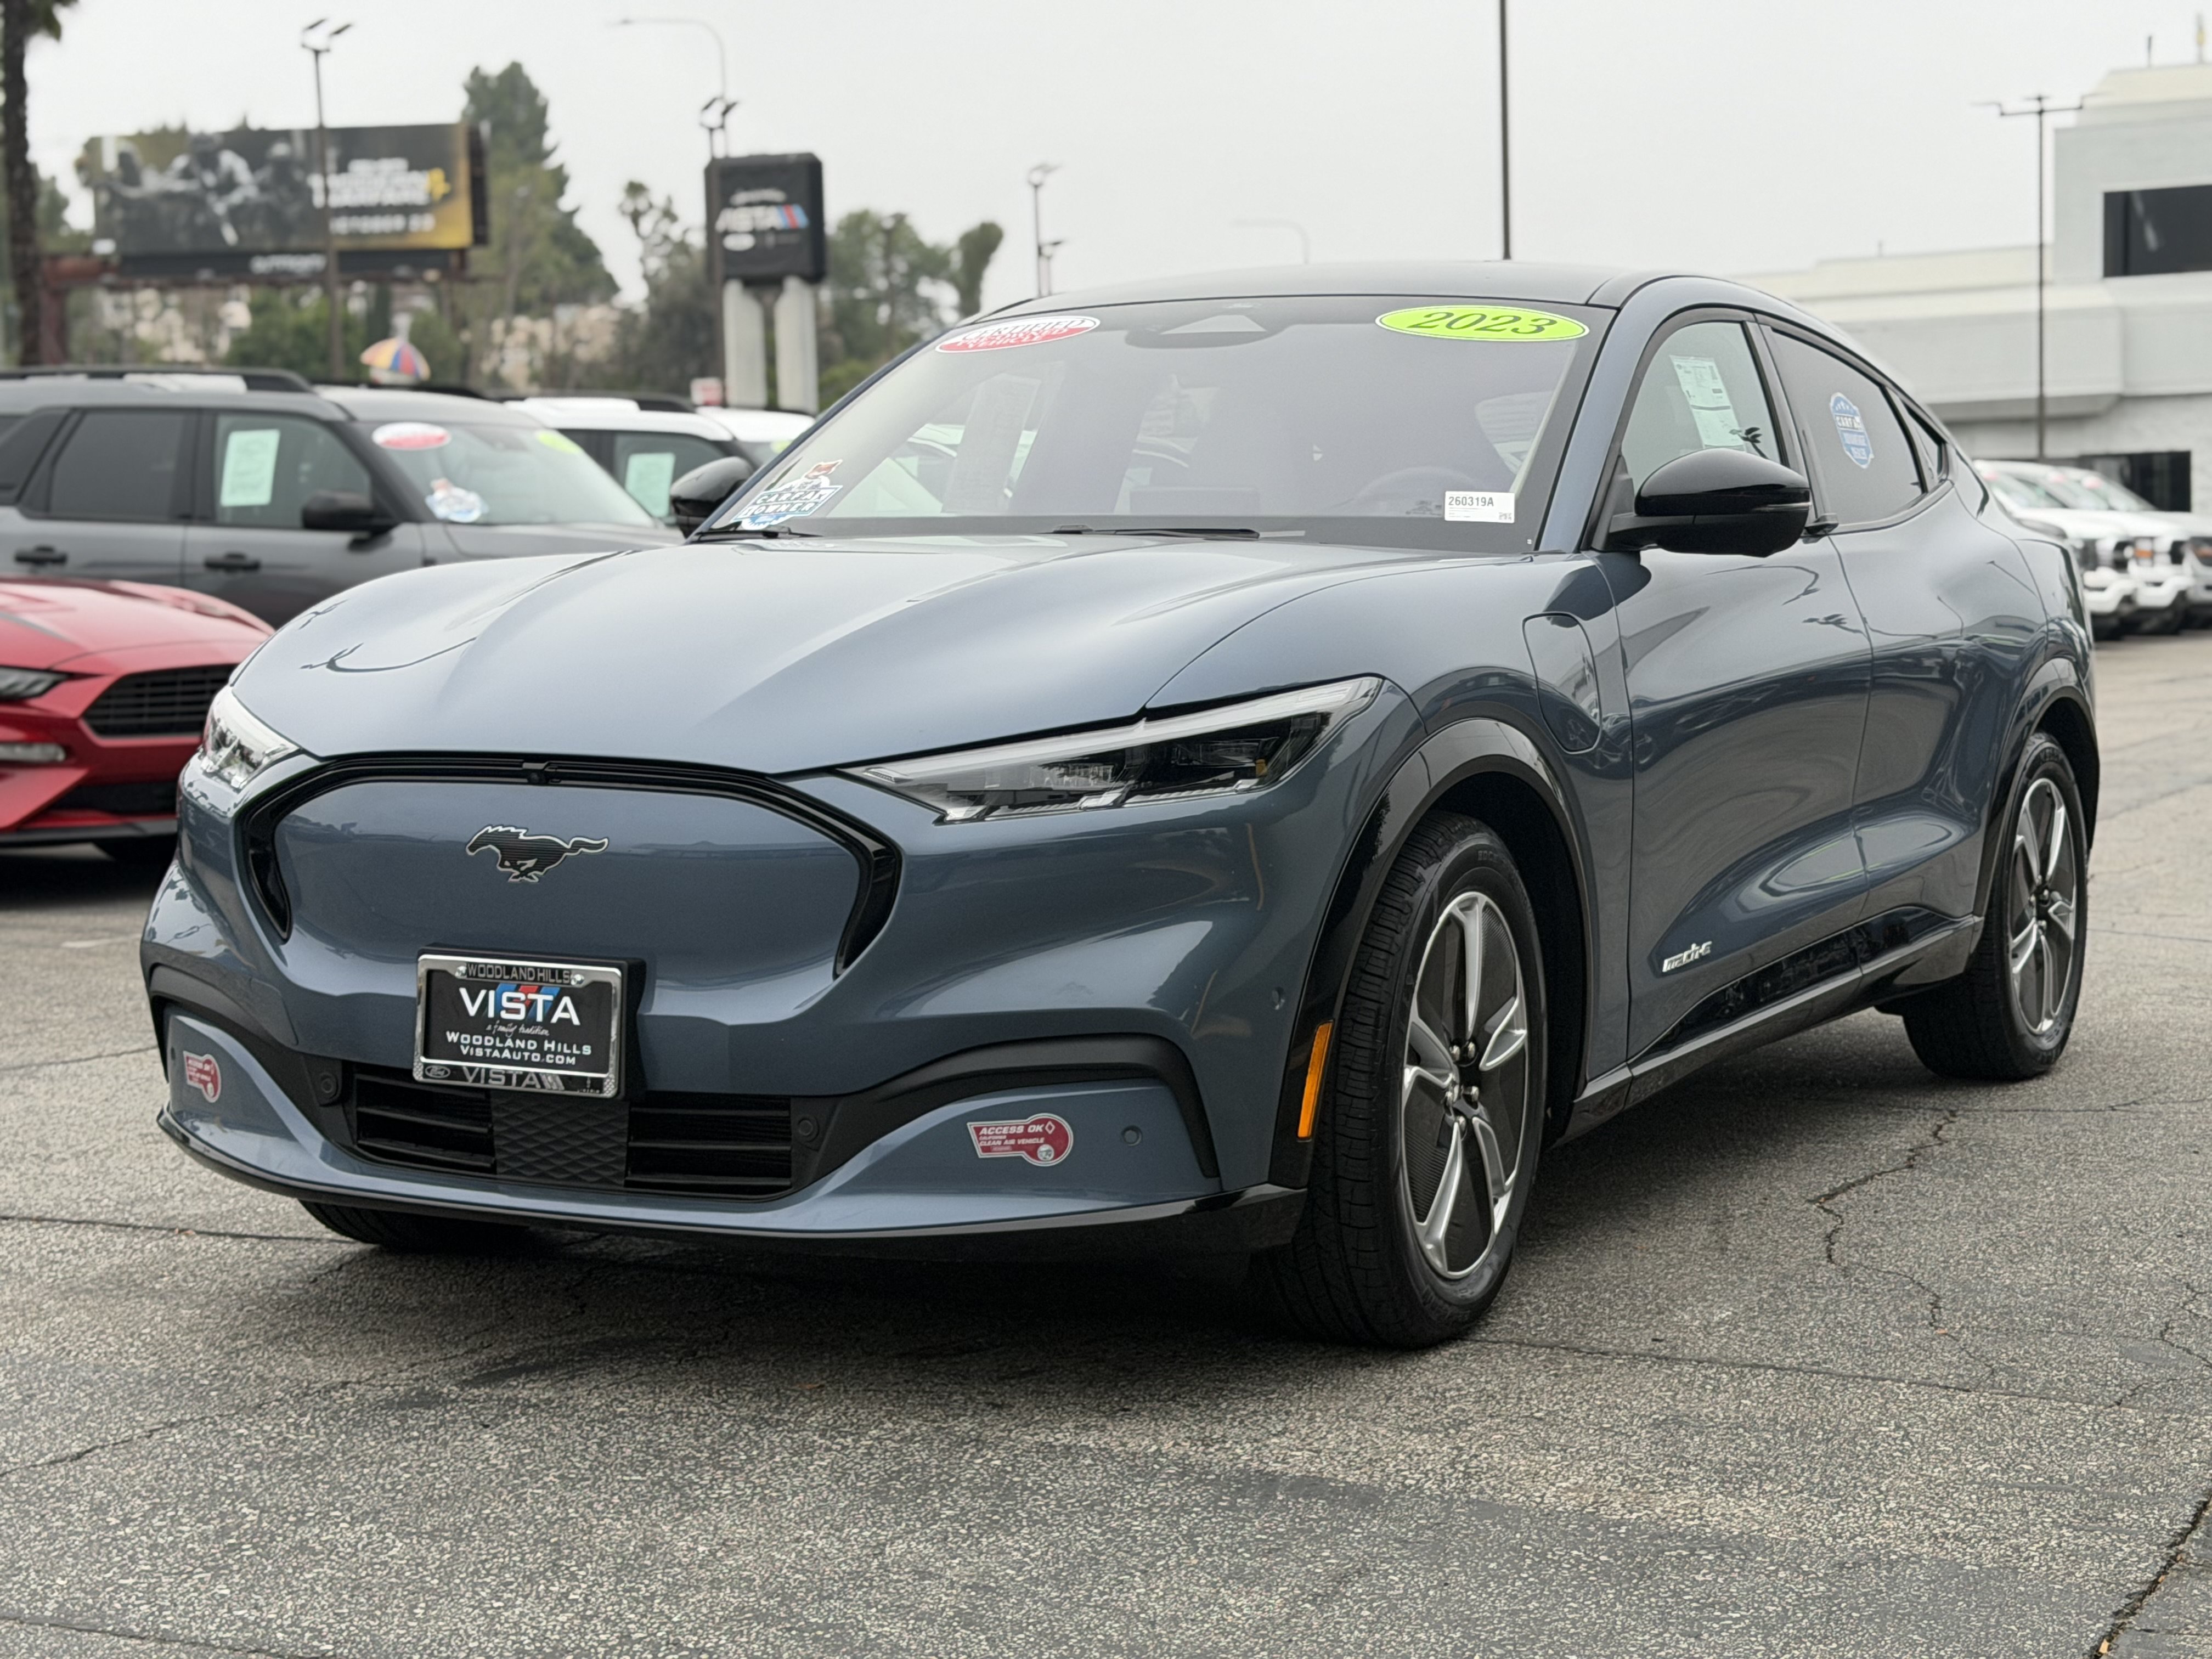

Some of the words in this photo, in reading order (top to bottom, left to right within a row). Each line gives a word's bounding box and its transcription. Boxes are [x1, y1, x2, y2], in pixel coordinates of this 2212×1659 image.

[962, 319, 1086, 340] CERTIFIED
[1407, 312, 1558, 334] 2023
[757, 490, 831, 504] CARFAX
[1448, 496, 1494, 506] 260319A
[754, 502, 815, 515] OWNER
[467, 964, 535, 981] WOODLAND
[537, 968, 571, 983] HILLS
[459, 988, 580, 1025] VISTA
[446, 1031, 537, 1050] WOODLAND
[544, 1040, 592, 1056] HILLS
[462, 1066, 541, 1090] VISTA
[979, 1125, 1024, 1135] ACCESS
[1028, 1124, 1045, 1133] OK
